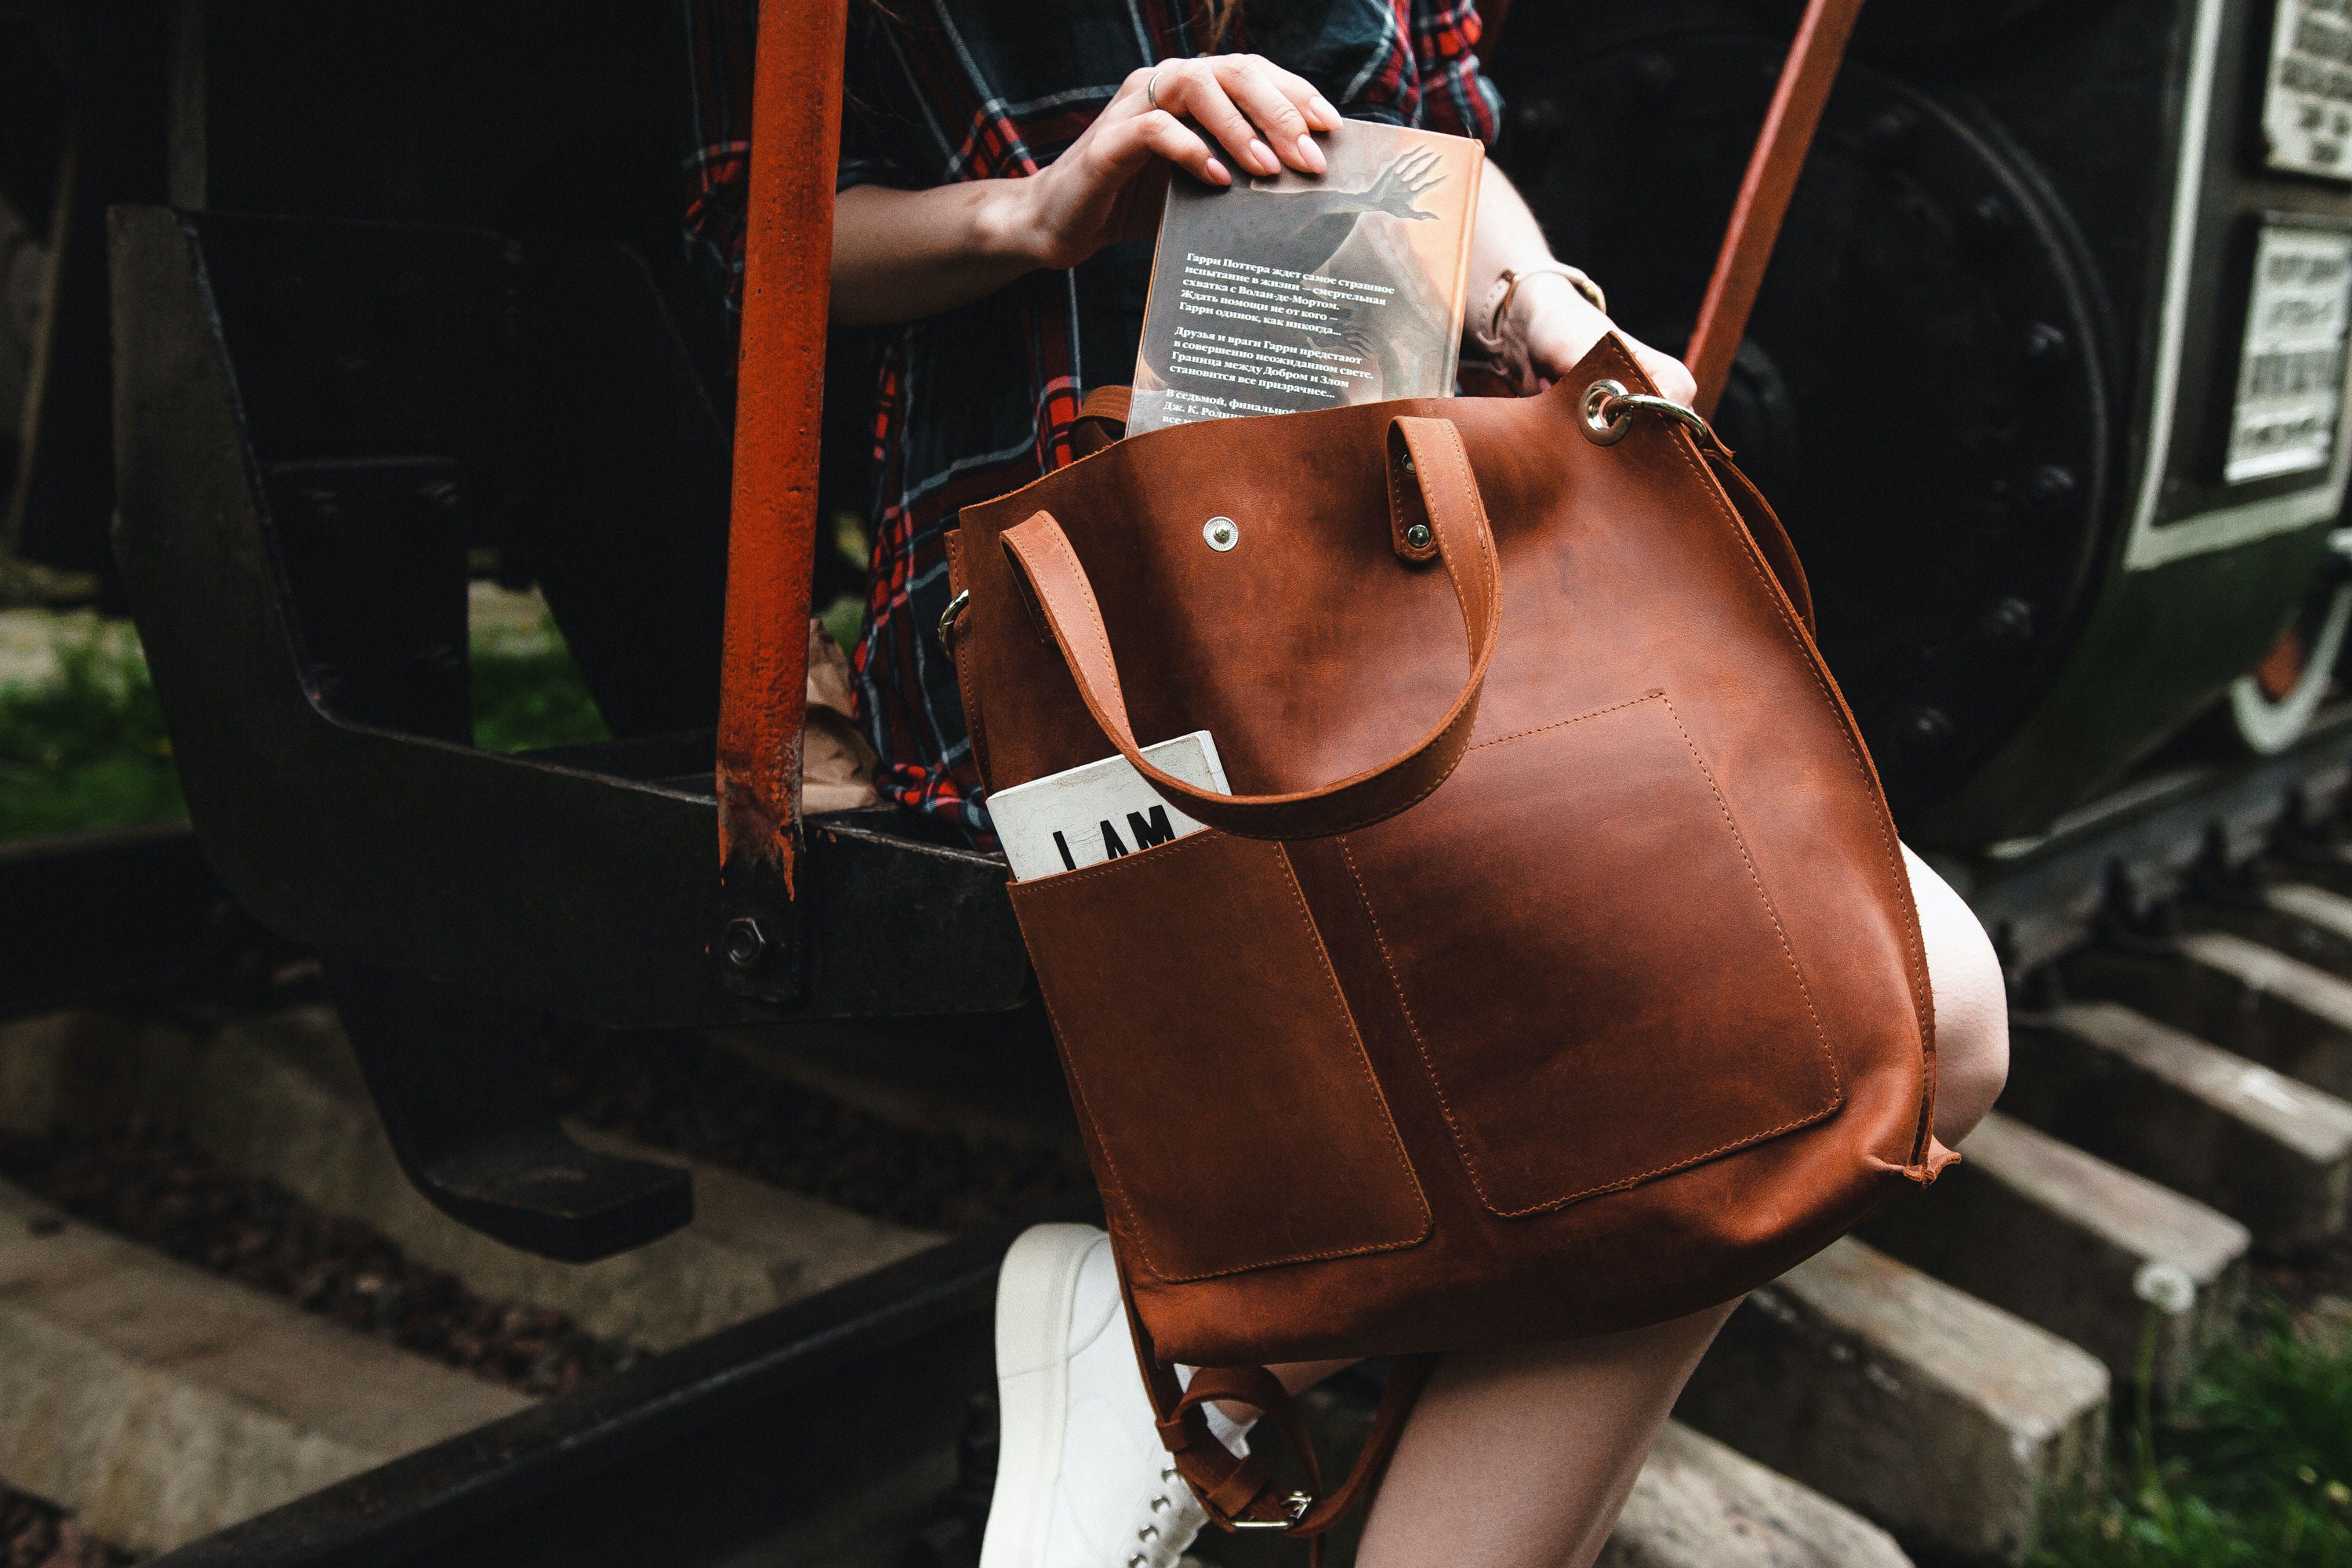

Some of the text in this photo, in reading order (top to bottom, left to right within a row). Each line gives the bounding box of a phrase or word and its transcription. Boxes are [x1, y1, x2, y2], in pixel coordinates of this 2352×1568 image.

[1185, 267, 1250, 282] испытание
[1261, 279, 1300, 291] жизни
[1312, 287, 1386, 306] смертельная
[1186, 252, 1395, 294] Гарри Поттера ждет самое страшное
[1181, 289, 1218, 303] Ждать
[1220, 297, 1269, 311] помощи
[1270, 305, 1284, 314] не
[1301, 310, 1327, 320] кого
[1182, 279, 1228, 292] схватка
[1239, 286, 1340, 310] Волан-де-Мортом.
[1179, 302, 1214, 314] Гарри
[1215, 309, 1261, 322] одинок,
[1263, 317, 1284, 326] как
[1174, 326, 1215, 340] Друзья
[1228, 337, 1261, 347] враги
[1264, 341, 1298, 354] Гарри
[1300, 349, 1362, 364] предстают
[1182, 342, 1254, 358] совершенно
[1256, 354, 1338, 373] неожиданном
[1340, 368, 1374, 379] свете.
[1170, 365, 1236, 381] становится
[1237, 376, 1257, 384] все
[1171, 351, 1221, 367] Граница
[1224, 361, 1263, 374] между
[1263, 367, 1308, 381] Добром
[1320, 376, 1349, 387] Злом
[1163, 401, 1185, 412] Дж.
[1187, 405, 1199, 414] К.
[1166, 389, 1174, 397] В
[1176, 393, 1227, 407] седьмой,
[1100, 804, 1176, 860] AM
